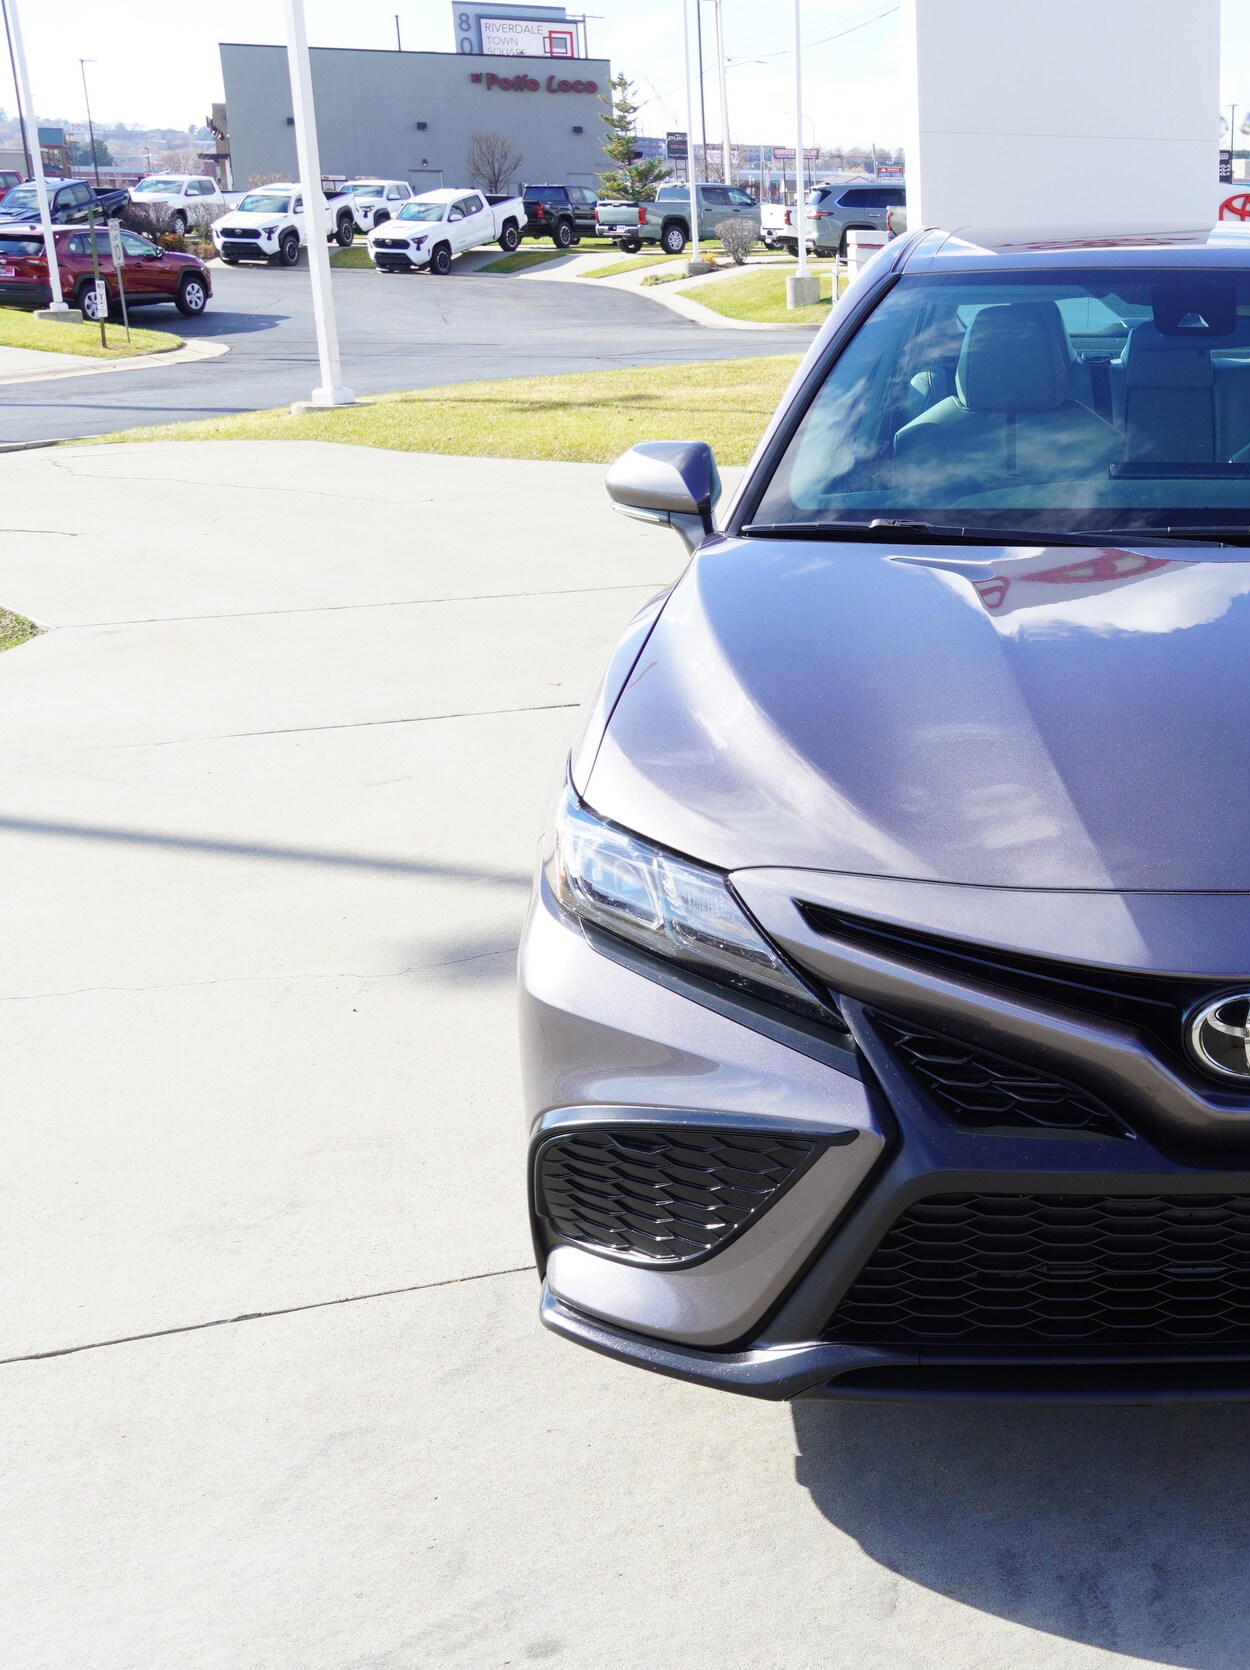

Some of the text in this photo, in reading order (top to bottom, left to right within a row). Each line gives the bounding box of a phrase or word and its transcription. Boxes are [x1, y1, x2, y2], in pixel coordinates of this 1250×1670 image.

[485, 22, 543, 35] RIVERDALE
[486, 36, 519, 46] TOWN
[486, 73, 540, 92] Pollo
[546, 75, 598, 94] Loco
